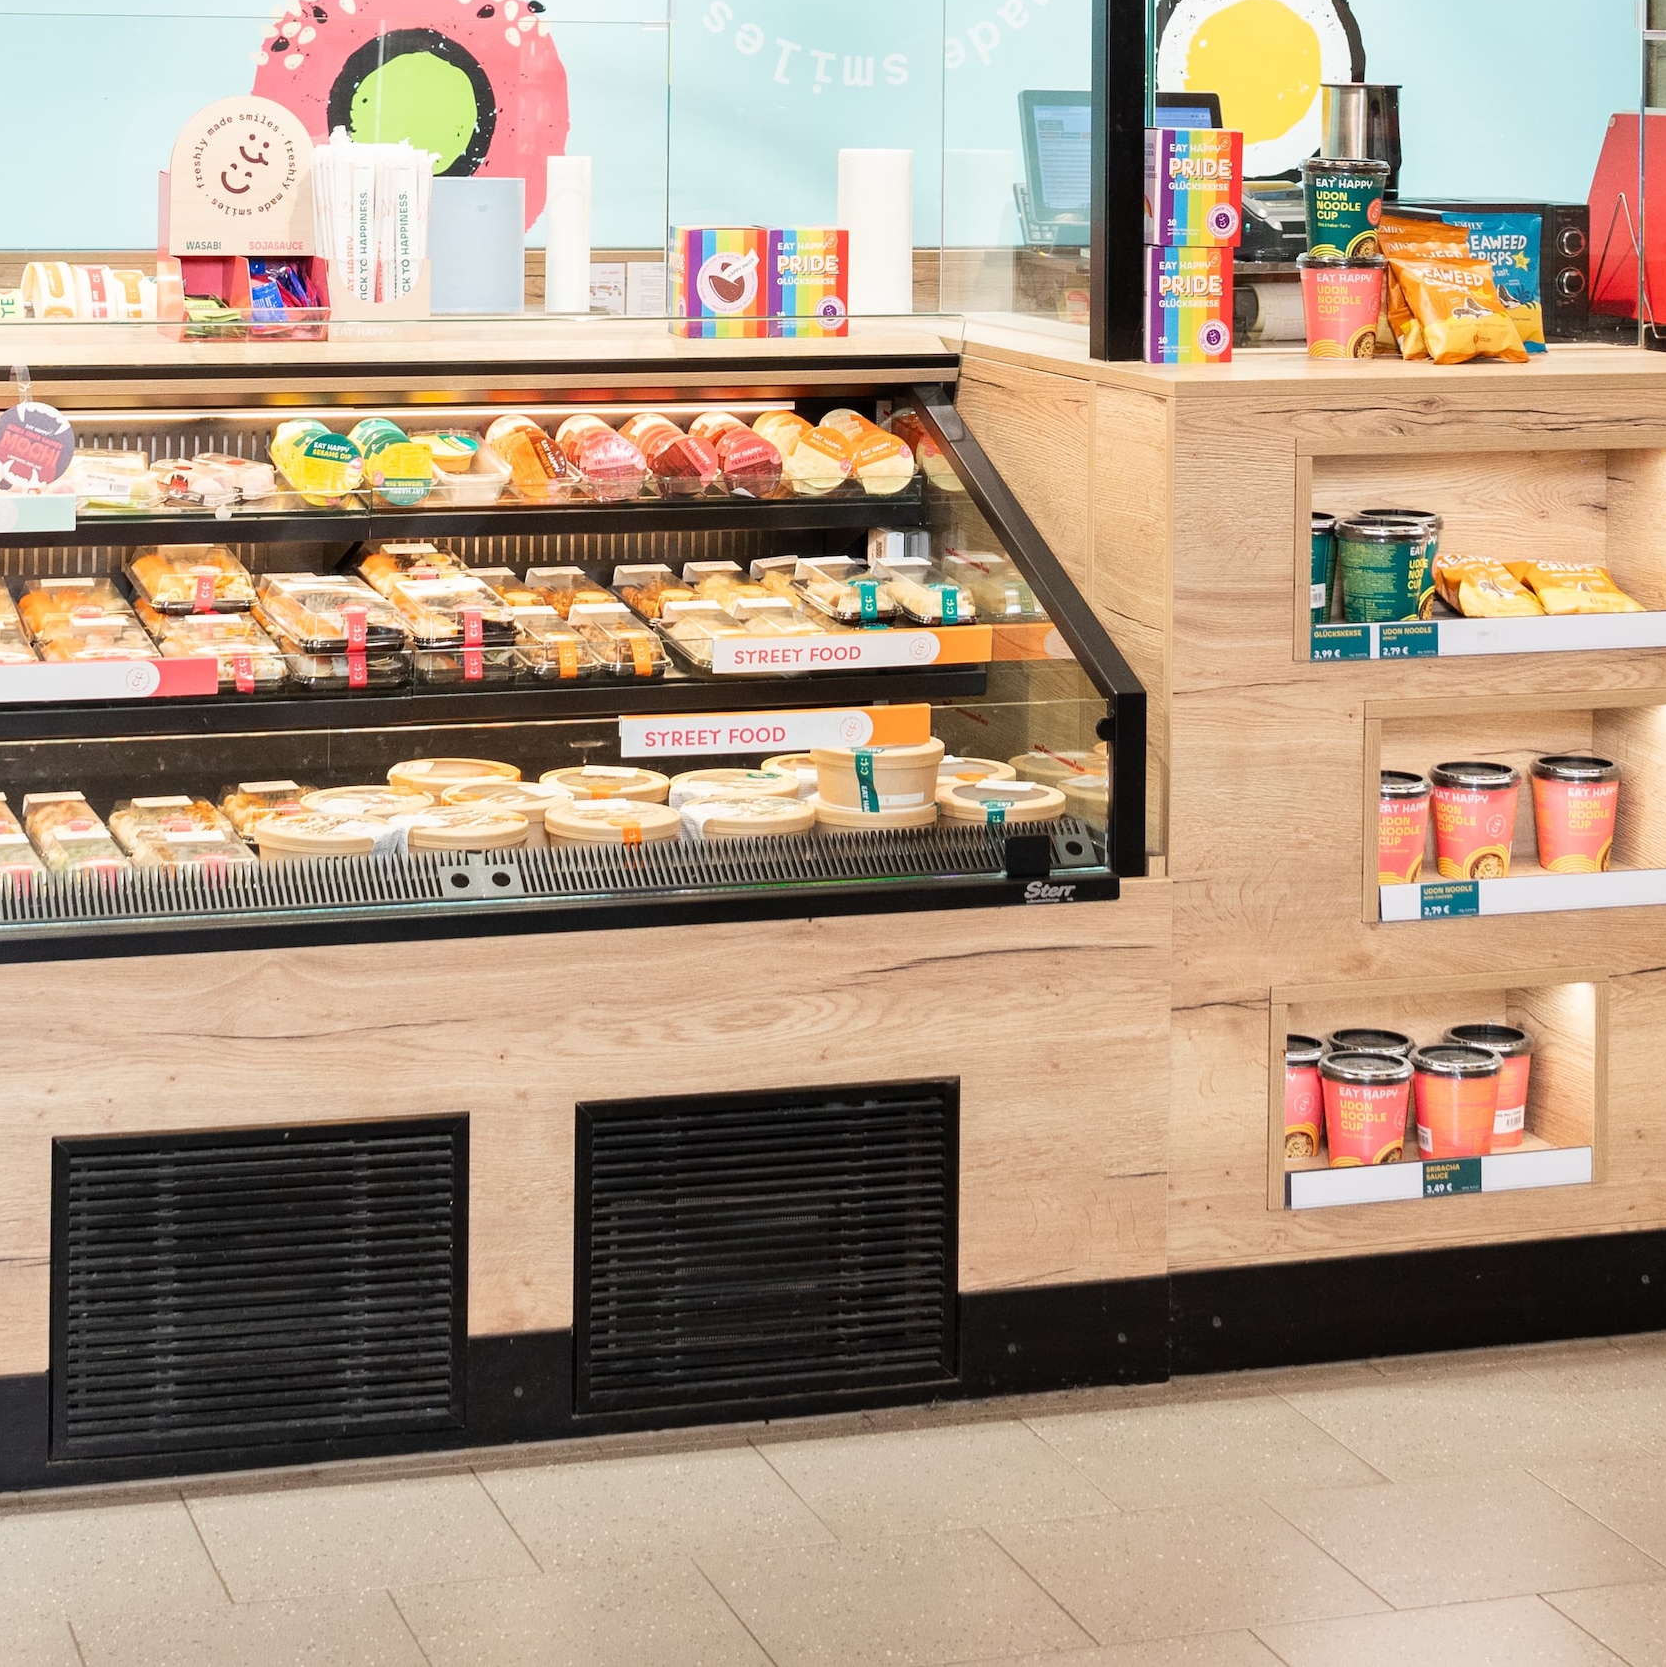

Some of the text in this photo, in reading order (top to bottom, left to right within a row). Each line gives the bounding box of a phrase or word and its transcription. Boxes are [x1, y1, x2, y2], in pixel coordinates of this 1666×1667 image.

[192, 112, 281, 190] freshly made smiles
[1168, 143, 1221, 153] EAT HAPPY
[1168, 157, 1234, 181] PRIDE
[210, 139, 297, 217] freshly made smiles
[1168, 180, 1230, 192] GLÜCKSKEKSE
[1315, 190, 1348, 201] UDON
[1316, 201, 1362, 212] NOODLE
[1316, 210, 1339, 221] CUP
[398, 190, 408, 256] HAPPINESS.
[1166, 218, 1178, 227] 10
[185, 240, 305, 251] WASABI SOJASAUCE
[777, 242, 796, 251] EAT
[359, 257, 368, 274] TO
[776, 254, 840, 276] PRIDE
[1158, 260, 1178, 271] EAT
[1496, 267, 1511, 277] salt
[1158, 274, 1224, 297] PRIDE
[1317, 285, 1349, 295] UDON
[1317, 294, 1362, 305] NOODLE
[1317, 304, 1340, 315] CUP
[1157, 336, 1168, 345] 10
[311, 449, 352, 461] SESAME DIP
[1313, 629, 1363, 639] GLÜCKSKEKSE
[1382, 626, 1433, 636] UDON NOODLE
[733, 645, 862, 666] STREET FOOD
[1313, 649, 1333, 660] 3,99
[1382, 646, 1402, 657] 2,79
[644, 726, 786, 747] STREET FOOD
[1568, 818, 1592, 830] CUP
[1023, 880, 1077, 900] Sterr
[1423, 884, 1473, 895] UDON NOODLE
[1423, 905, 1442, 917] 2,79
[1338, 1099, 1374, 1113] UDON
[1339, 1110, 1388, 1123] NOODLE
[1340, 1119, 1364, 1132] CUP
[1425, 1163, 1461, 1173] SRIRACHA
[1425, 1171, 1449, 1181] SAUCE
[1426, 1183, 1445, 1195] 3,49
